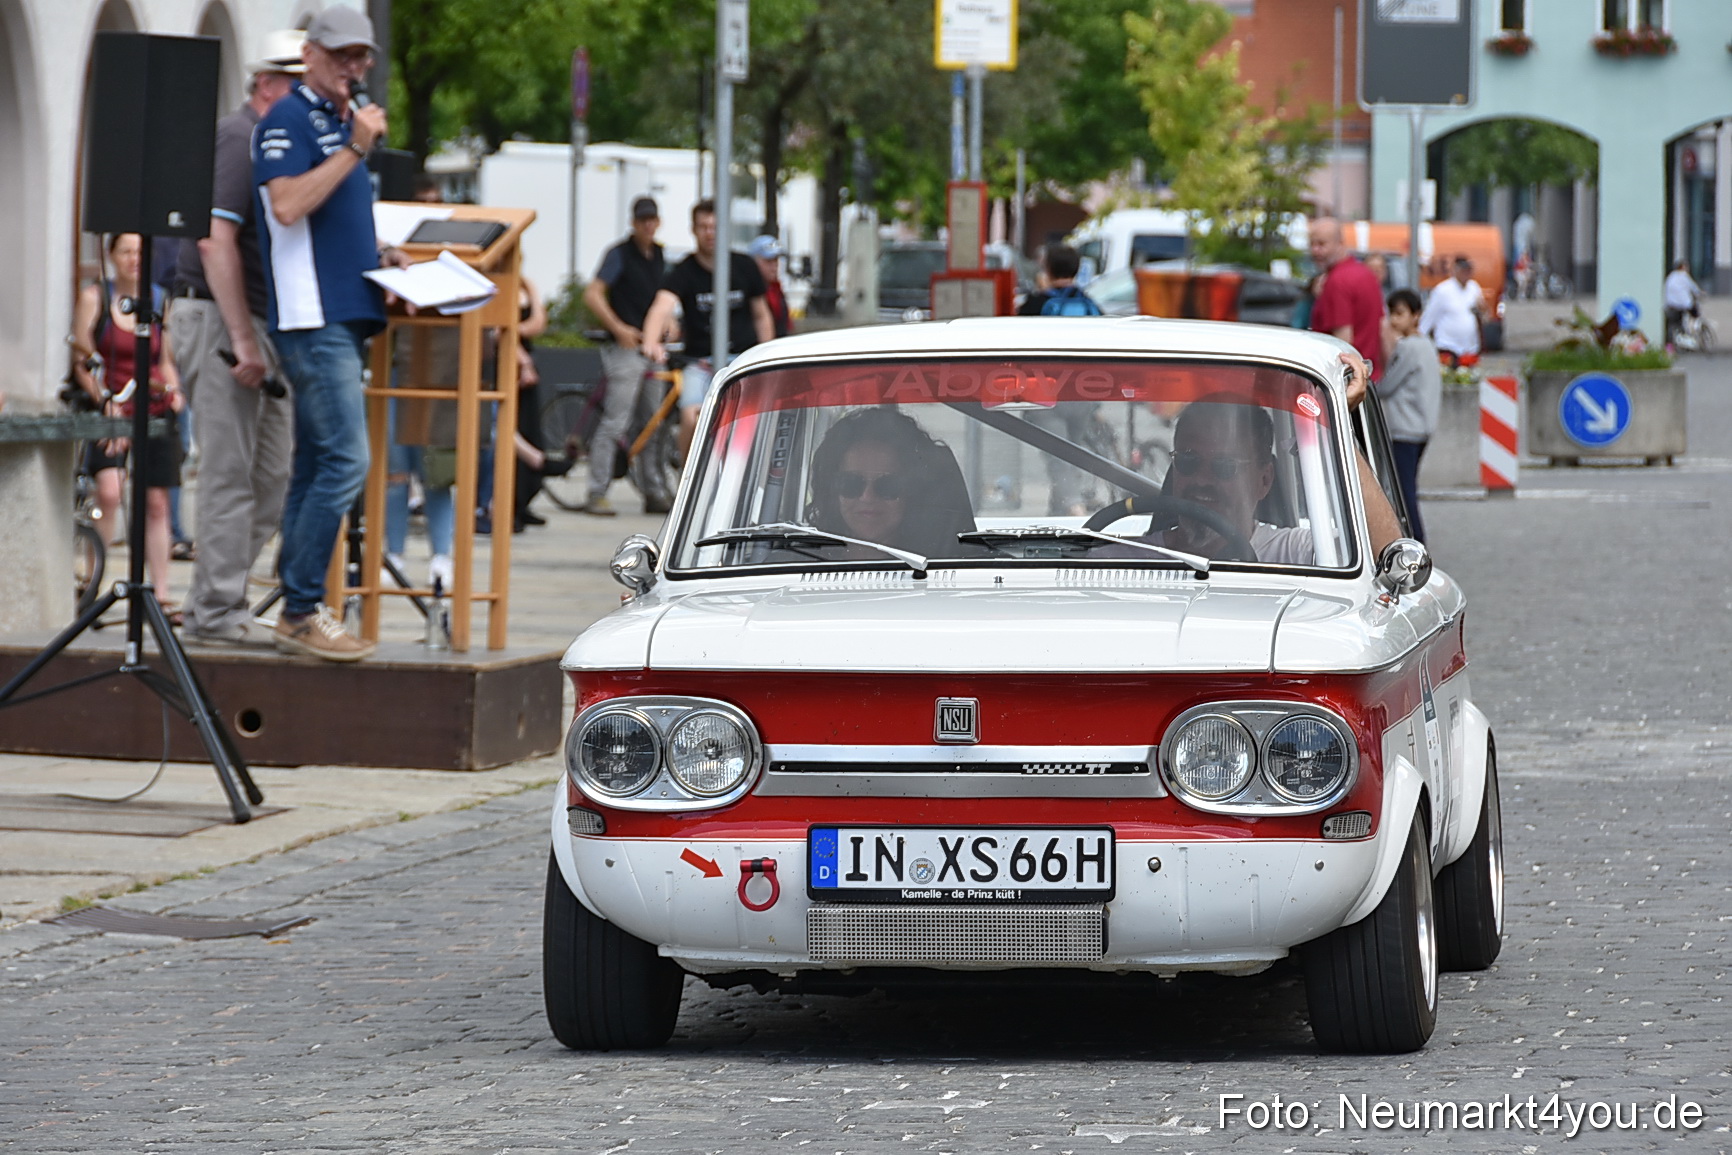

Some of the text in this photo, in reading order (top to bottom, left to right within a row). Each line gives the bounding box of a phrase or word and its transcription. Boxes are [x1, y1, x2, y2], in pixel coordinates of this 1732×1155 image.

[883, 364, 1115, 399] Above
[943, 708, 969, 731] NSU
[1084, 764, 1111, 774] TT
[819, 866, 830, 879] D
[845, 837, 904, 881] IN
[901, 889, 941, 899] Kamelle
[951, 890, 964, 899] de
[967, 889, 992, 899] Prinz
[995, 889, 1014, 899] kütt
